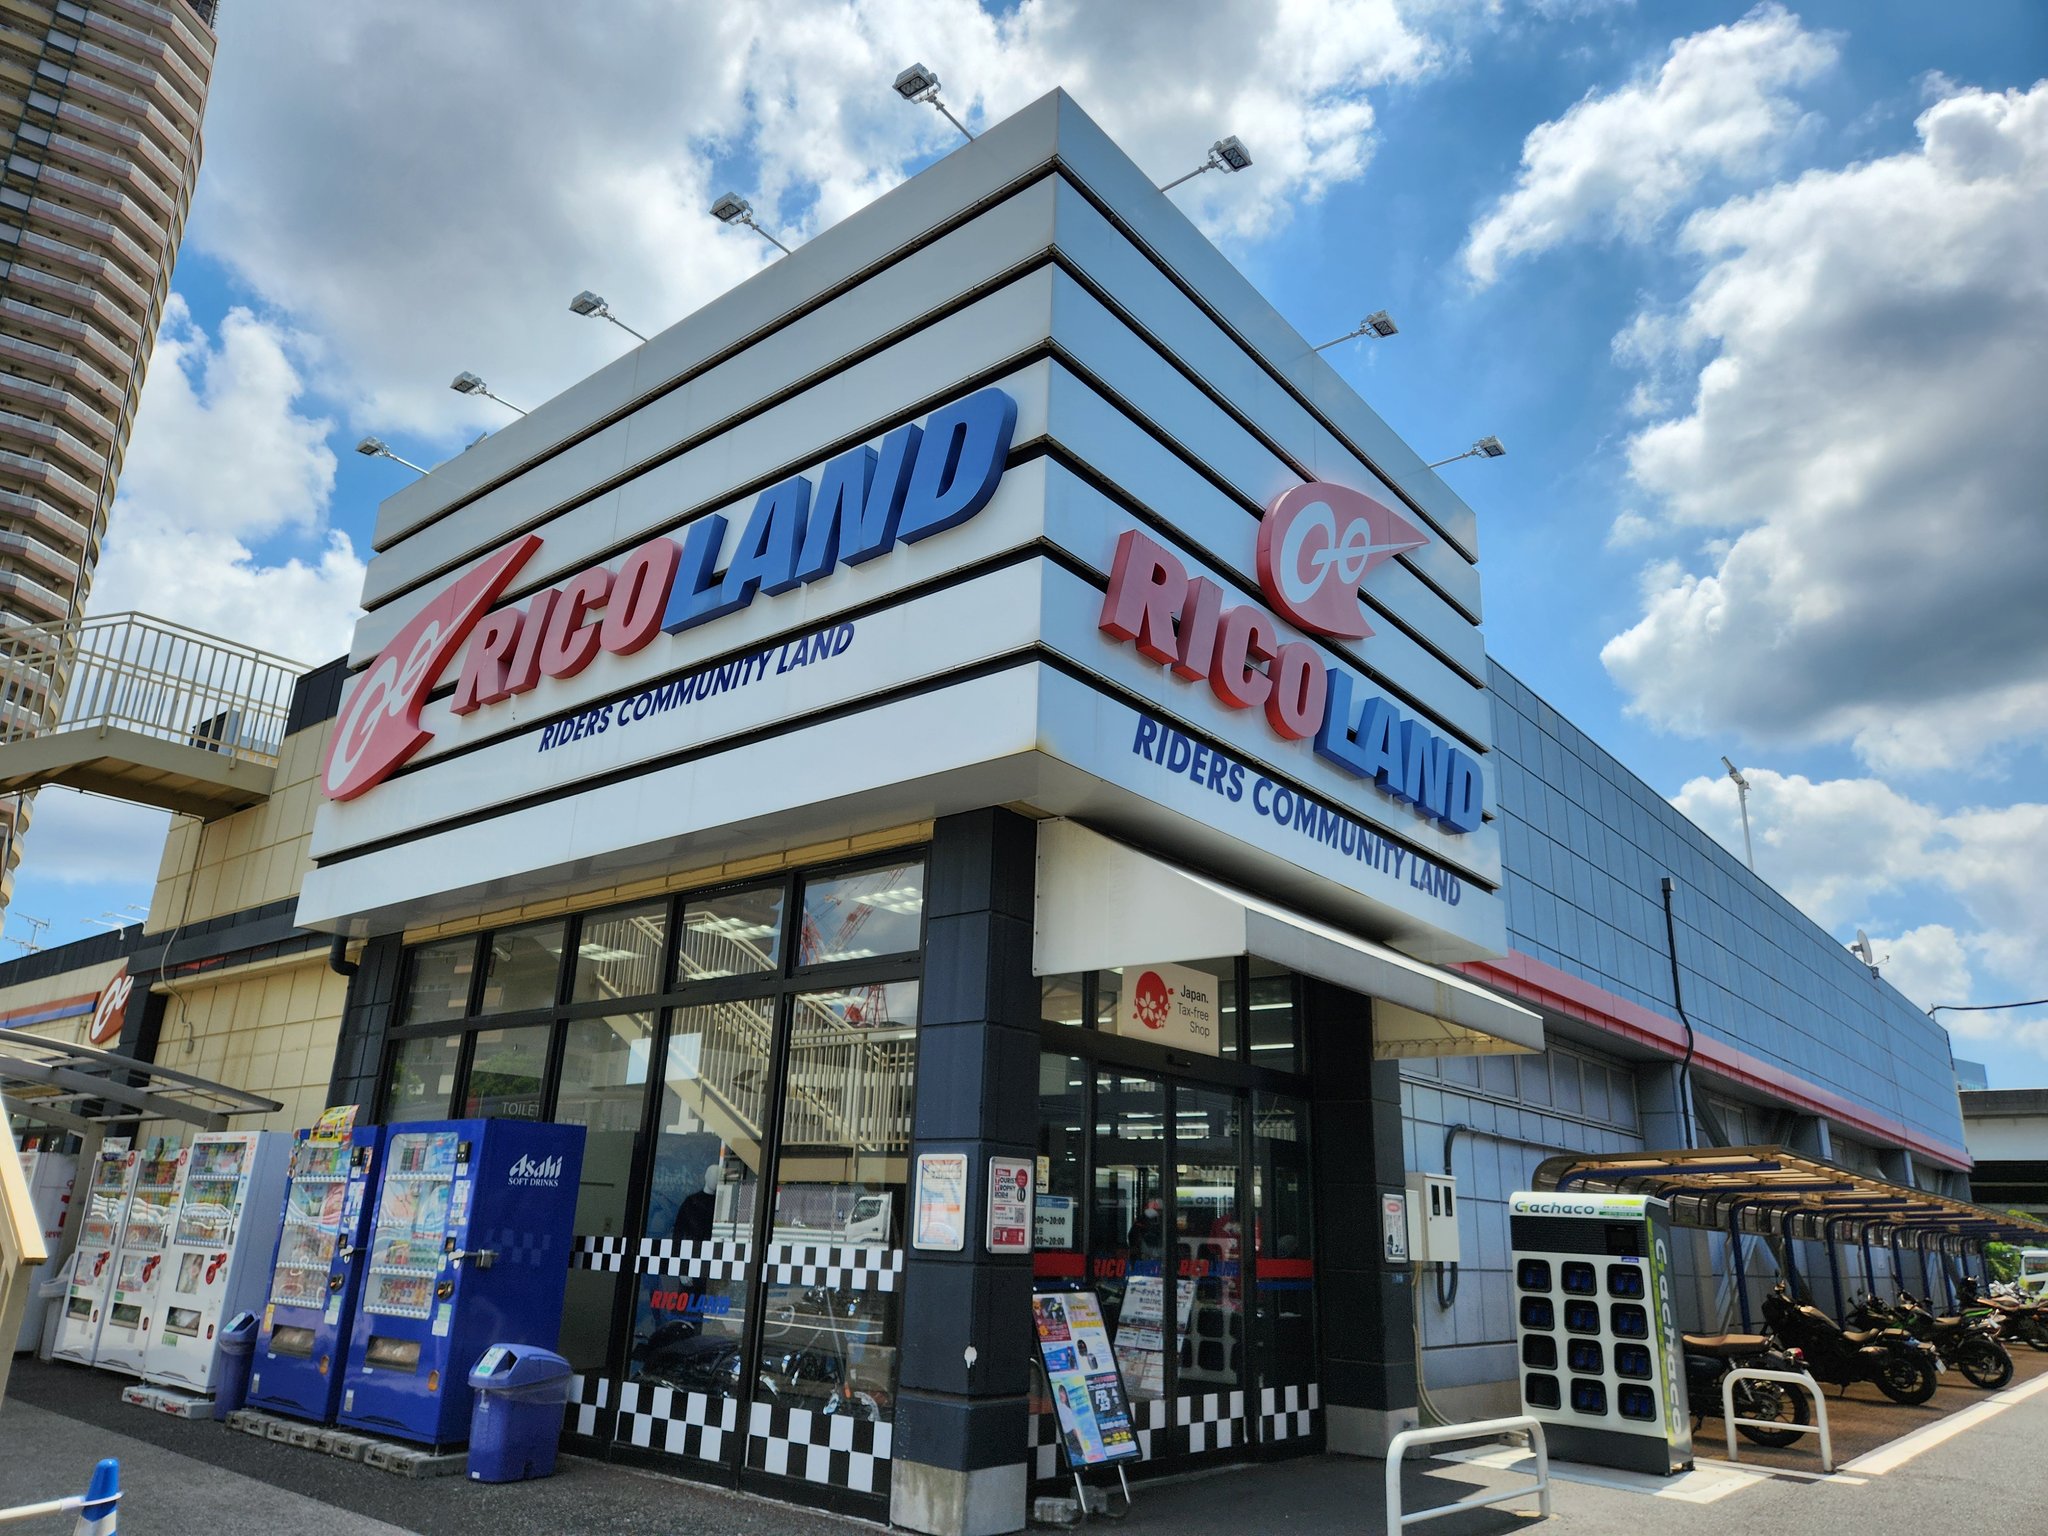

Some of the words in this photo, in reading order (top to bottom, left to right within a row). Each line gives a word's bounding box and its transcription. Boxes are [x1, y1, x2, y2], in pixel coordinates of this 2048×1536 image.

[450, 387, 1017, 715] RICOLAND
[538, 705, 613, 752] RIDERS
[617, 648, 775, 727] COMMUNITY
[776, 622, 855, 676] LAND
[1099, 529, 1483, 834] RICOLAND
[1132, 714, 1245, 802] RIDERS
[1253, 778, 1407, 880] COMMUNITY
[1410, 848, 1462, 907] LAND
[1180, 985, 1209, 1004] Japan.
[1177, 1002, 1209, 1022] Tax-free
[1190, 1021, 1210, 1038] Shop
[502, 1102, 540, 1117] TOILET
[509, 1153, 563, 1179] Asahi
[508, 1177, 528, 1186] SOFT
[529, 1178, 559, 1188] DRINKS
[1515, 1201, 1595, 1215] Gachaco
[651, 1290, 732, 1315] RICOLAND
[1655, 1238, 1682, 1435] Gachaco
